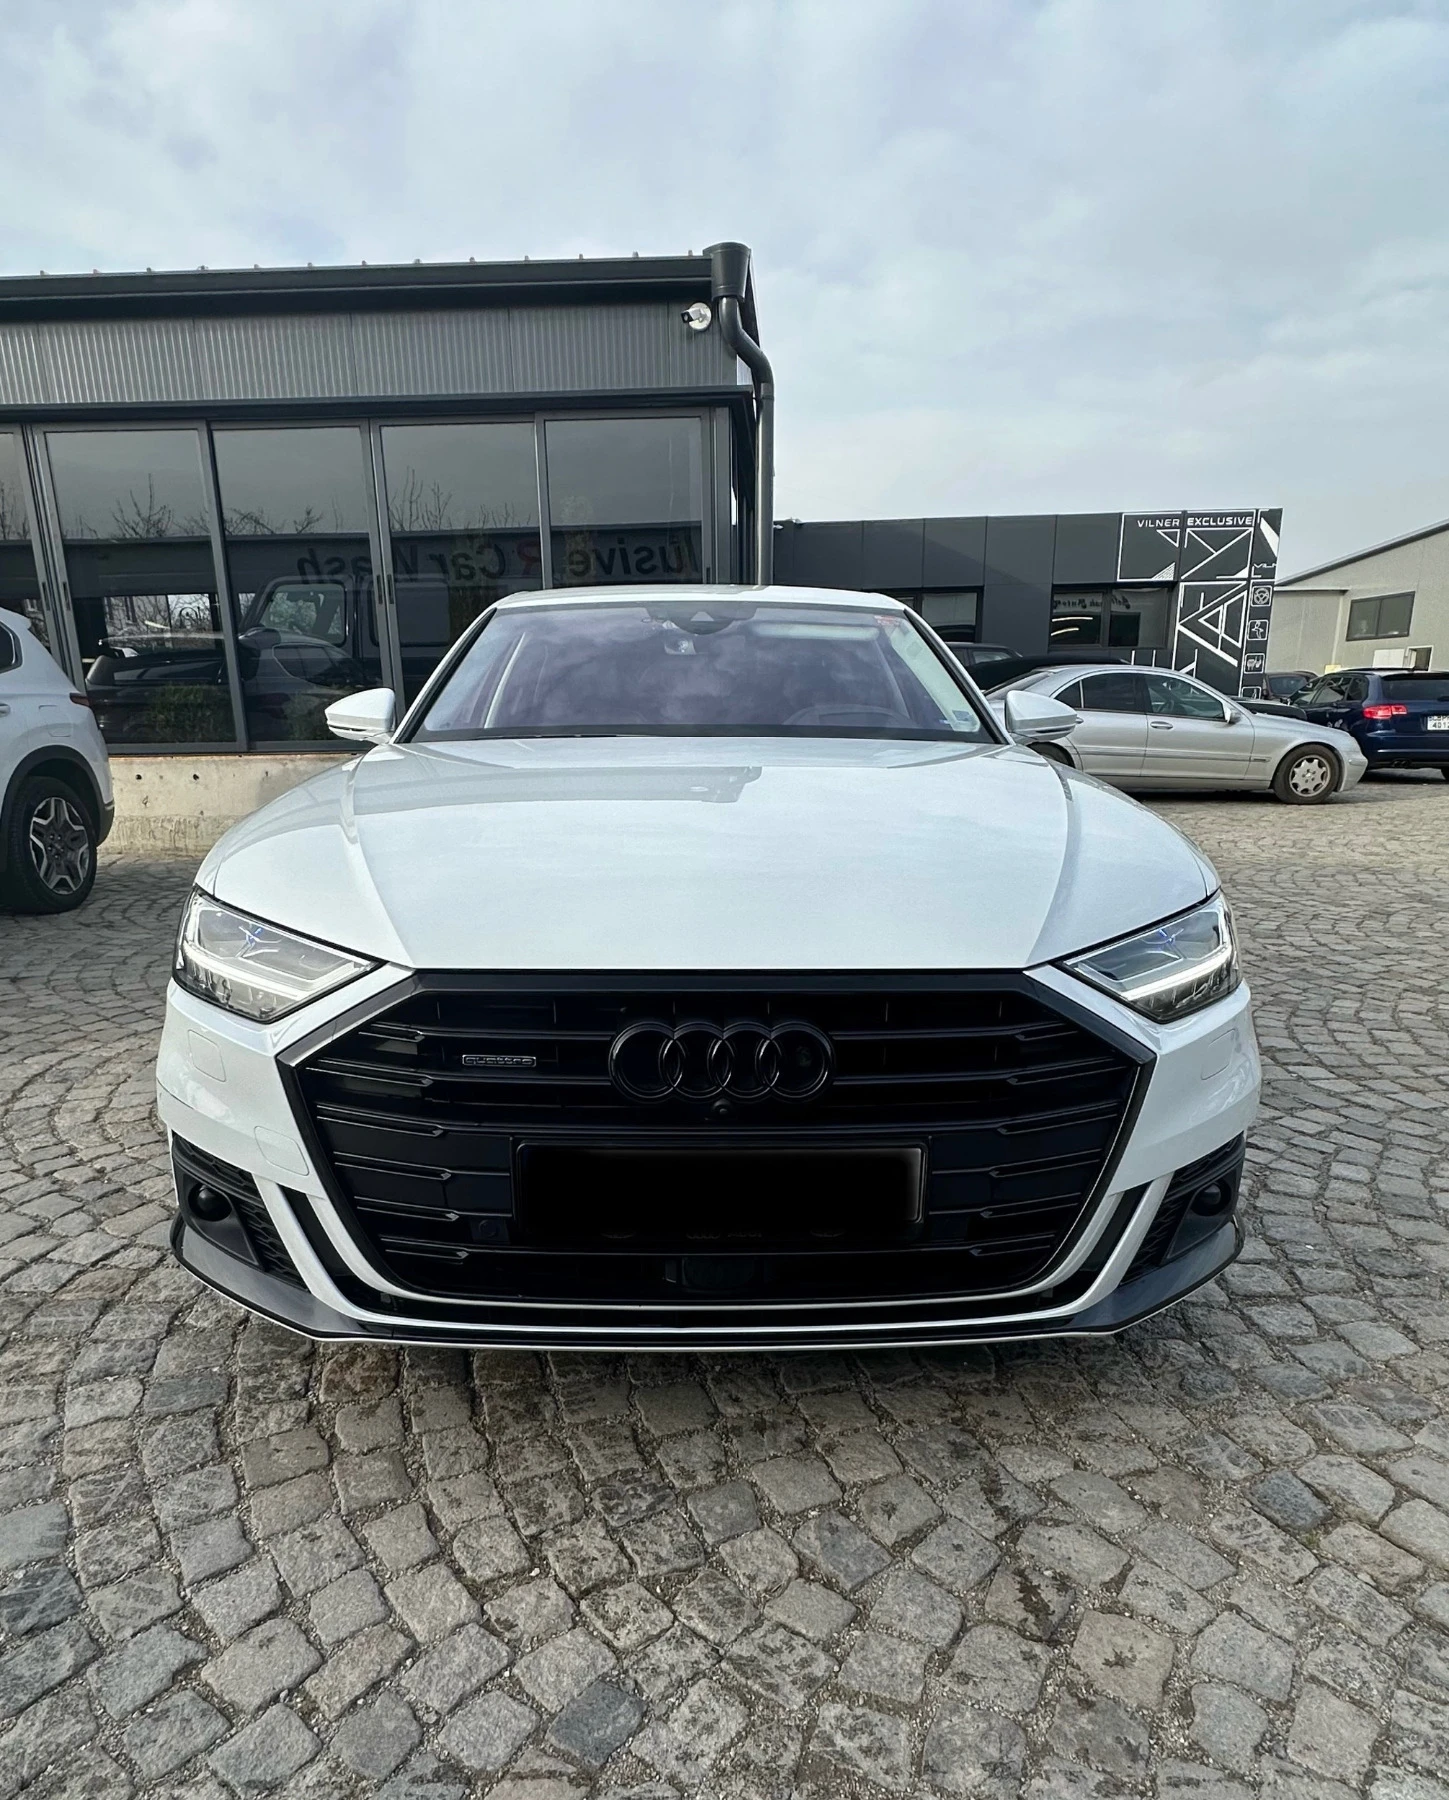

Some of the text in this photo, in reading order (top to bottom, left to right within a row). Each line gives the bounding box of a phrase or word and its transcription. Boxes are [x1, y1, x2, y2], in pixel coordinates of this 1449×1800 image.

[1137, 516, 1253, 527] VILNER EXCLUSIVE
[464, 1056, 534, 1066] quattro
